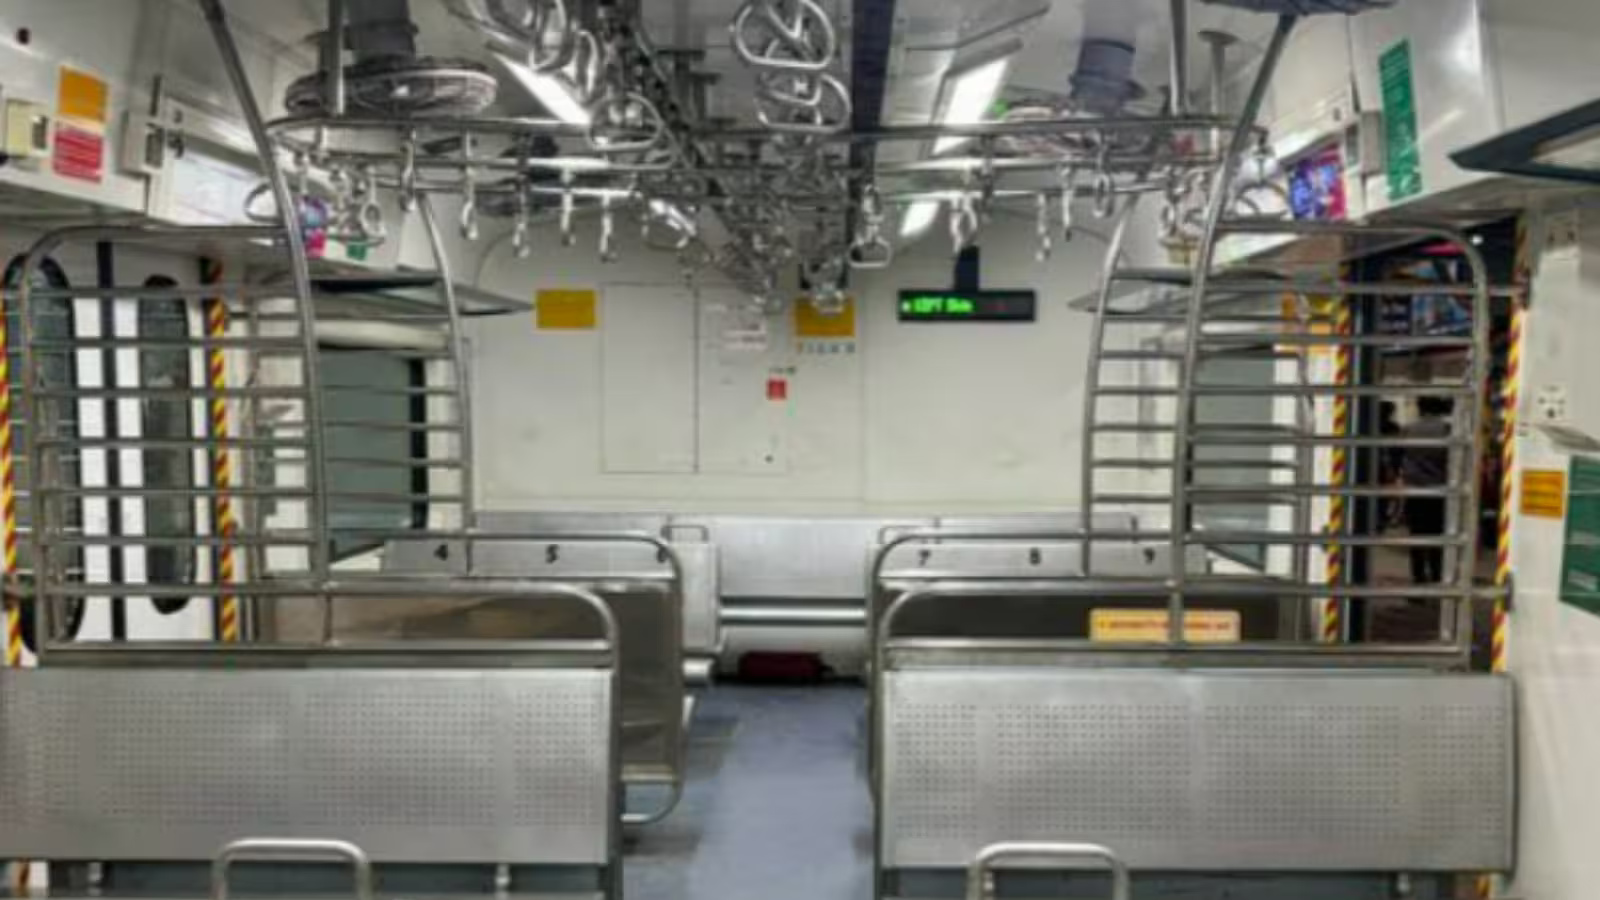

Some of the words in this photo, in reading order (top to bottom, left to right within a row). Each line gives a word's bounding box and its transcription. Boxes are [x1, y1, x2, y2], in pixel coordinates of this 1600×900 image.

[433, 543, 449, 561] 4
[545, 543, 560, 564] 5
[917, 549, 931, 566] 7
[1029, 547, 1041, 565] 8
